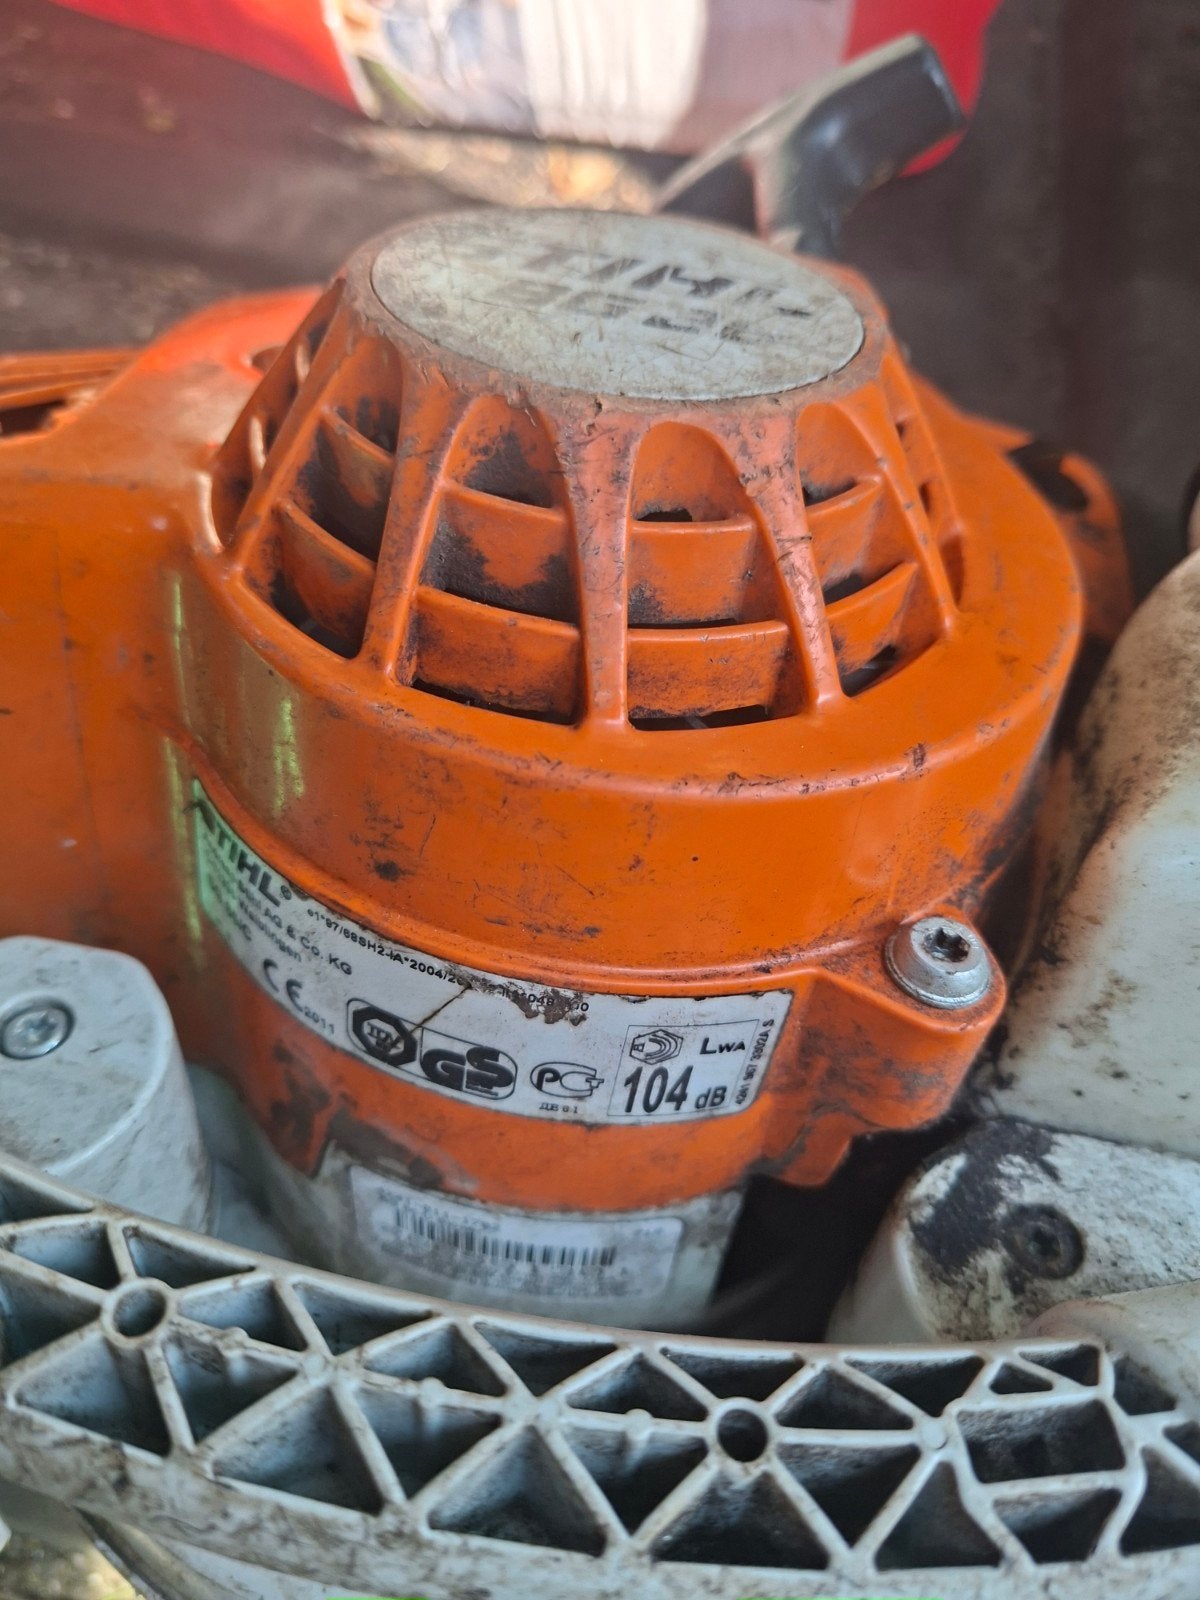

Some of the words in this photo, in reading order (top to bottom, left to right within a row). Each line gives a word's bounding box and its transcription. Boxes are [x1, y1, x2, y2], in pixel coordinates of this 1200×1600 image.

[328, 953, 352, 975] KG
[623, 1064, 694, 1114] 104
[694, 1085, 728, 1110] dB
